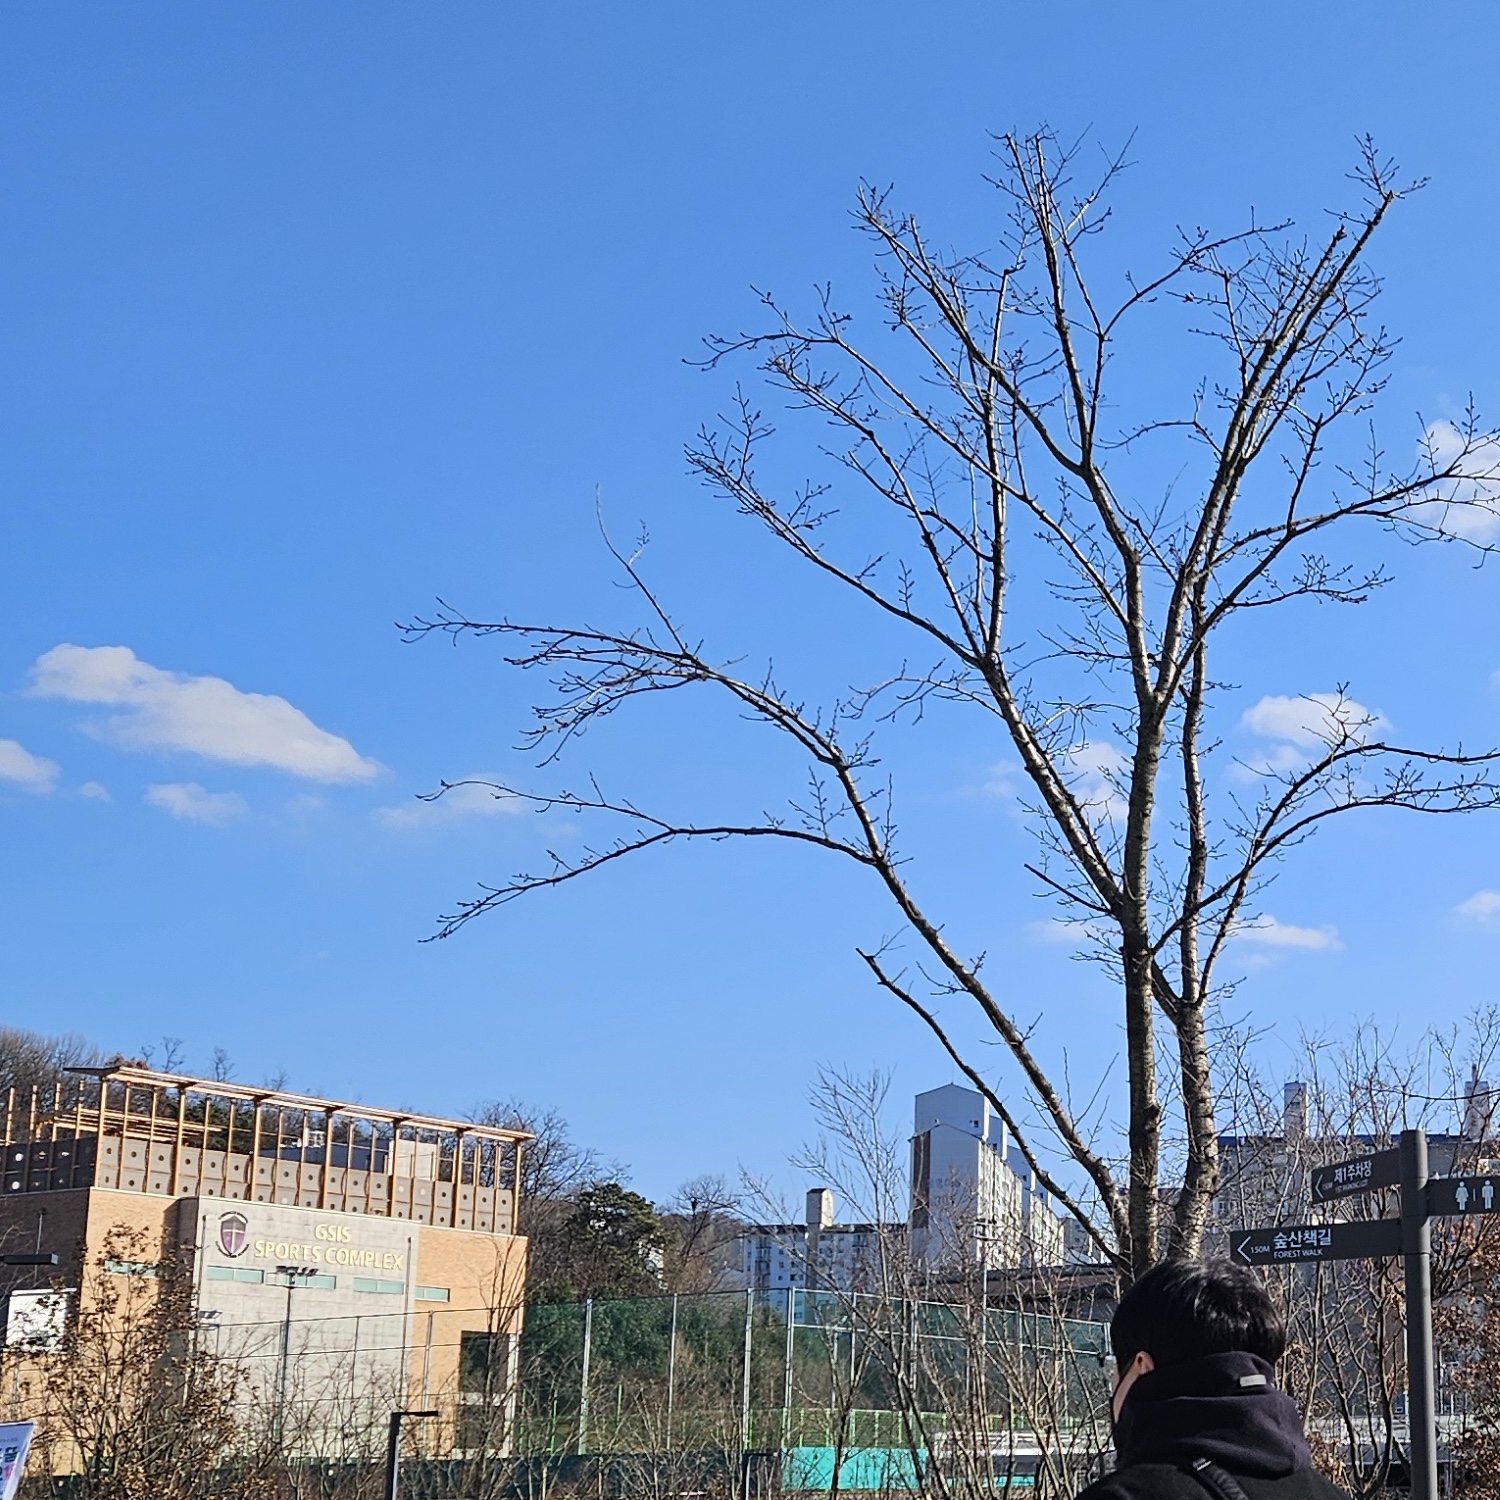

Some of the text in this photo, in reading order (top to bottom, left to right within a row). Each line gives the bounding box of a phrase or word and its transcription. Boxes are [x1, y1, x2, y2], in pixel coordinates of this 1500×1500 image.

[1334, 1160, 1372, 1183] 제1주차장
[314, 1223, 351, 1243] GSIS
[1273, 1228, 1332, 1250] 숲산책길
[254, 1240, 405, 1270] SPORTS COMPLEX
[1250, 1245, 1271, 1254] 150M
[1274, 1248, 1324, 1259] FOREST WALK
